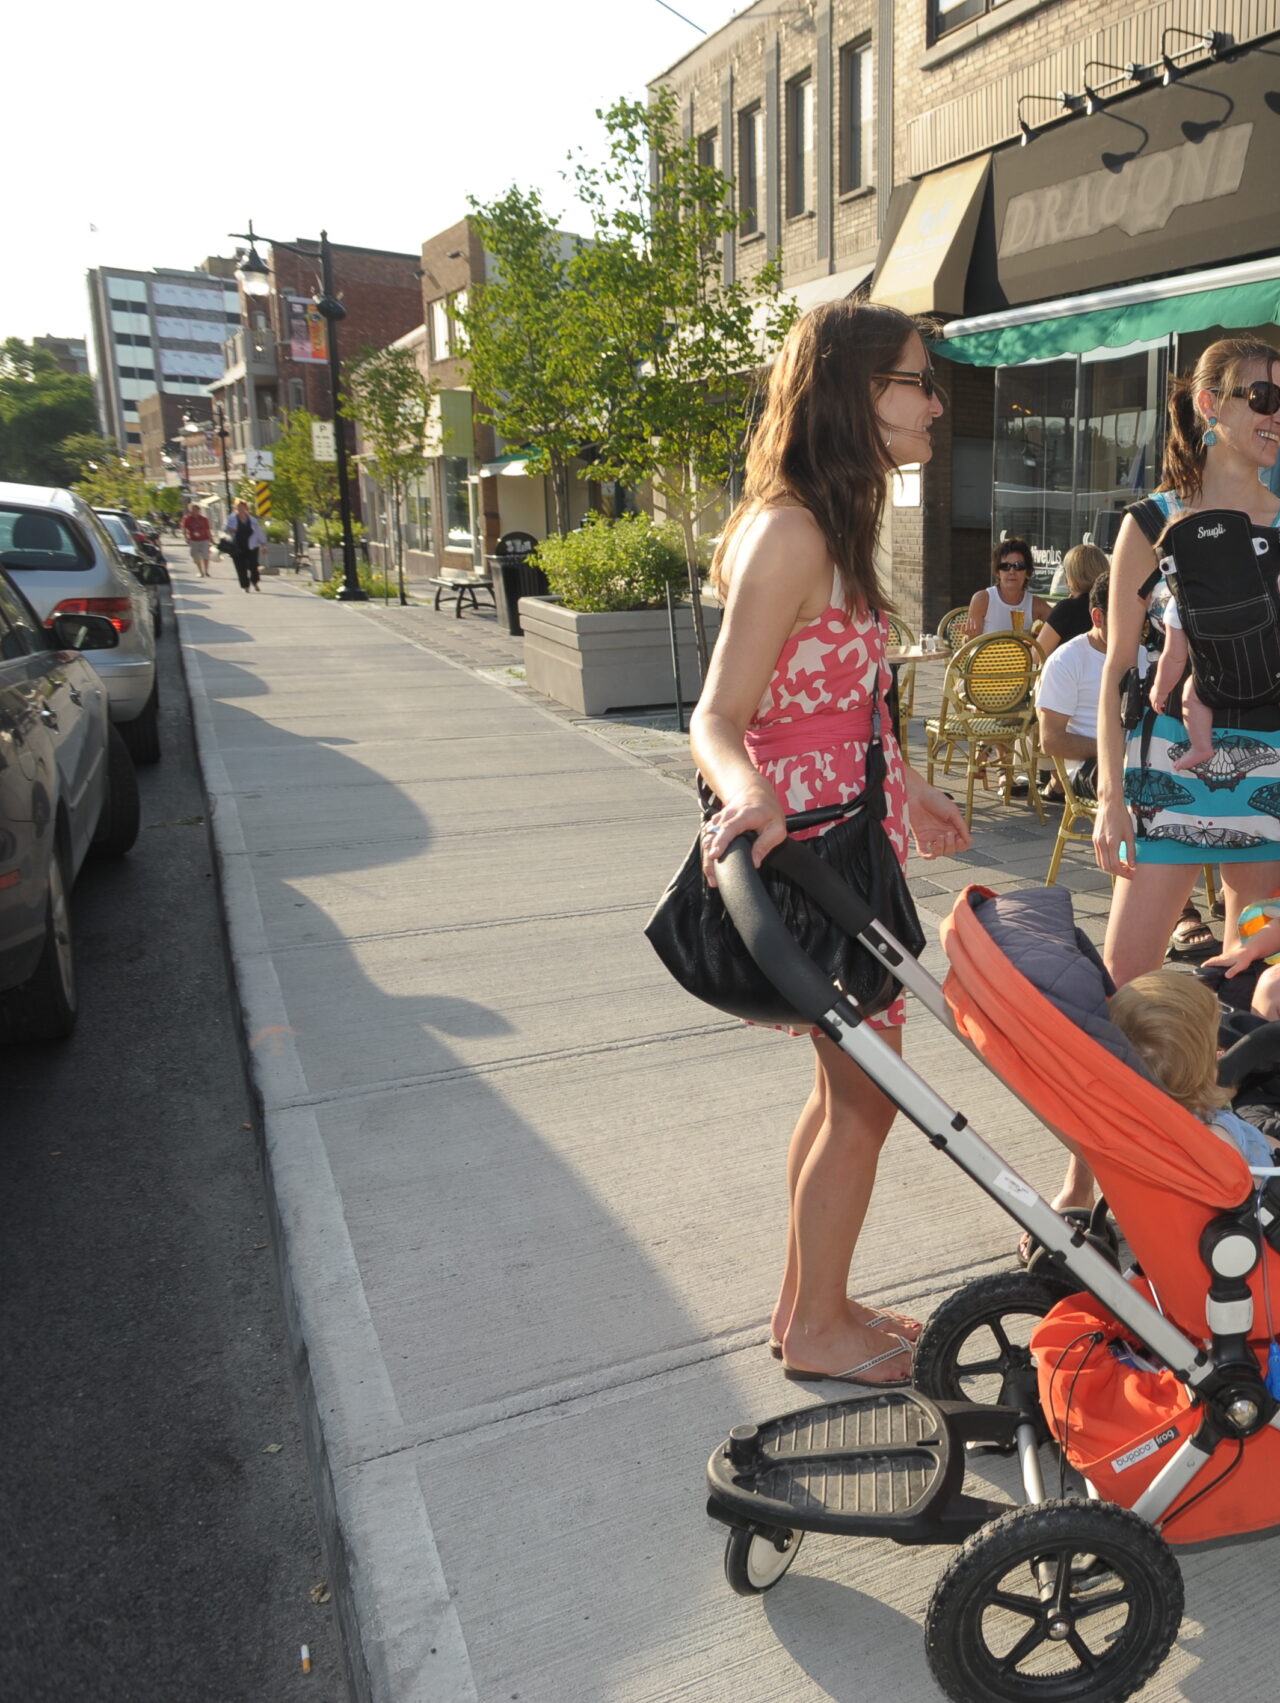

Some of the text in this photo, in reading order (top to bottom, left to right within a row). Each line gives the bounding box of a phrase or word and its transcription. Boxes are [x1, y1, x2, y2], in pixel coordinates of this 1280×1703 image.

[1000, 123, 1252, 257] DRAGONE
[1197, 523, 1224, 539] Snugli
[1155, 1429, 1175, 1445] frog
